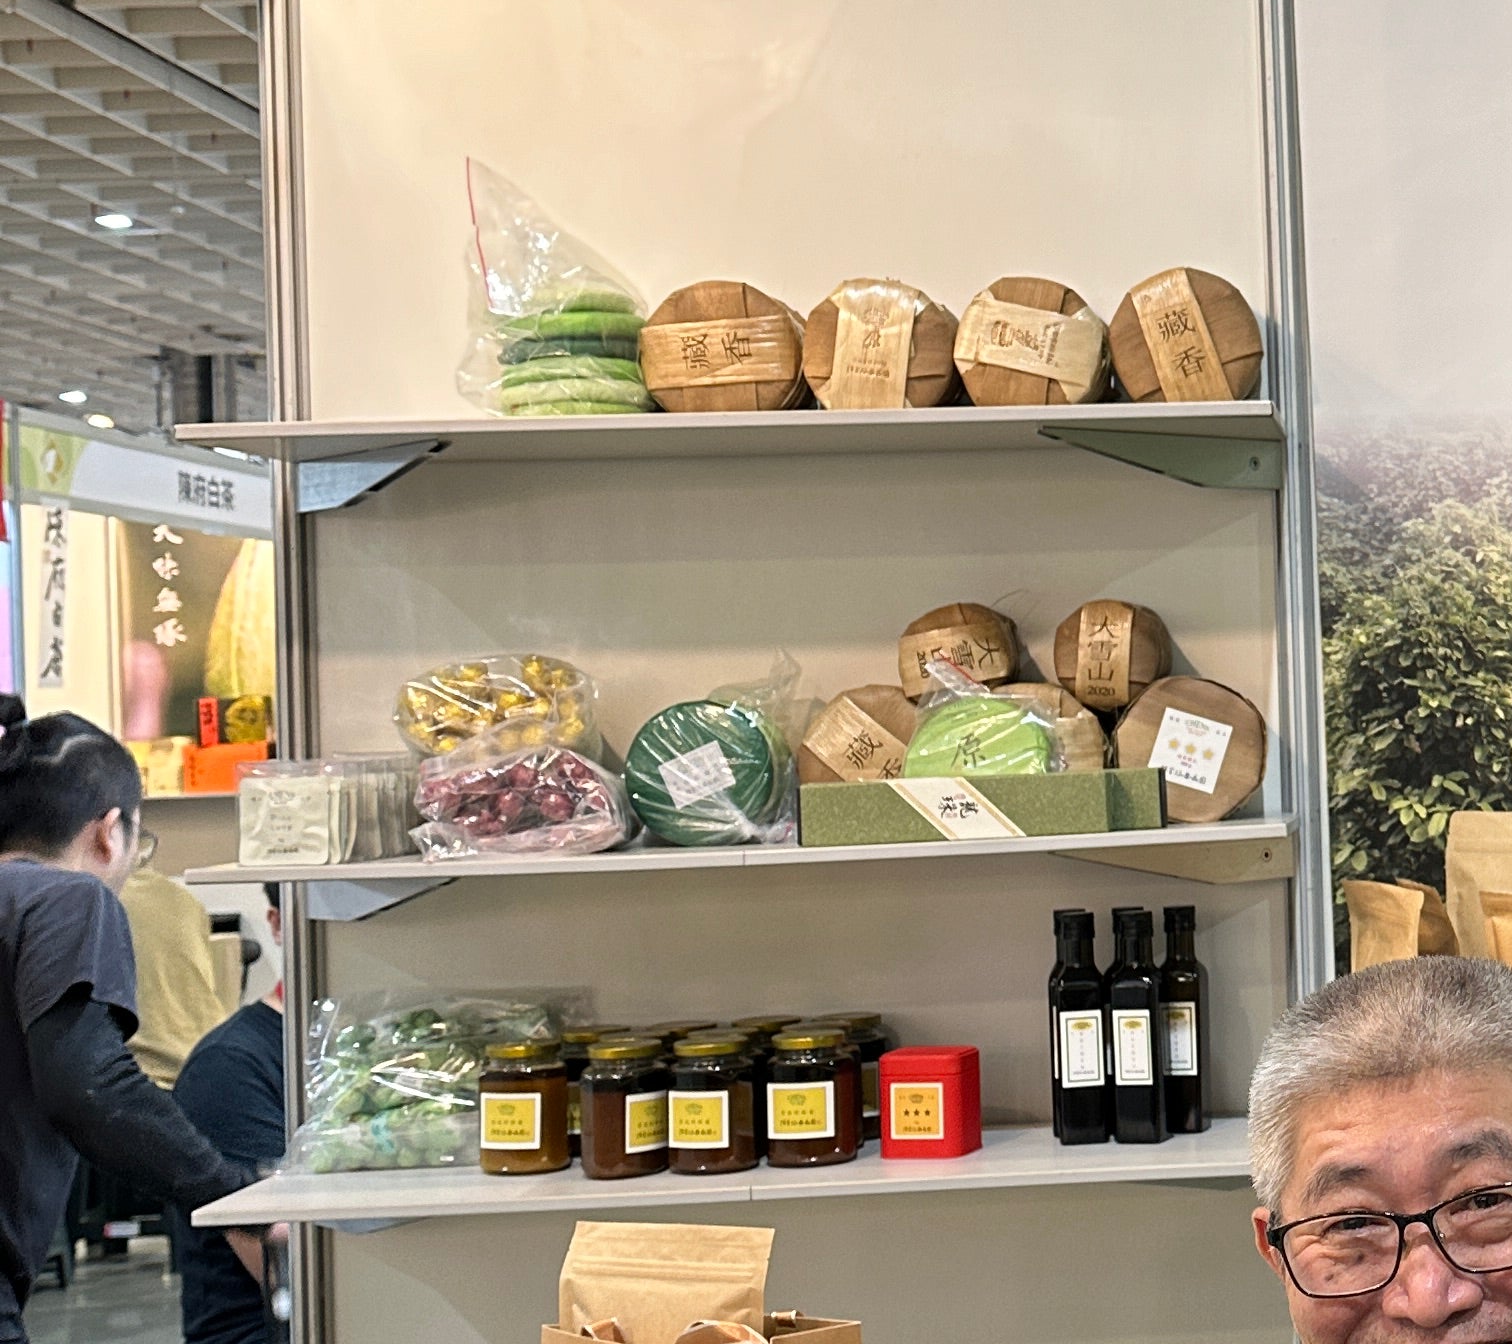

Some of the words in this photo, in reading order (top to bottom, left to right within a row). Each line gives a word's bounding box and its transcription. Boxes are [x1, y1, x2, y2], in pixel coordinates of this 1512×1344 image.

[681, 330, 752, 371] 藏香
[1153, 308, 1207, 380] 藏香
[1087, 686, 1116, 697] 2020
